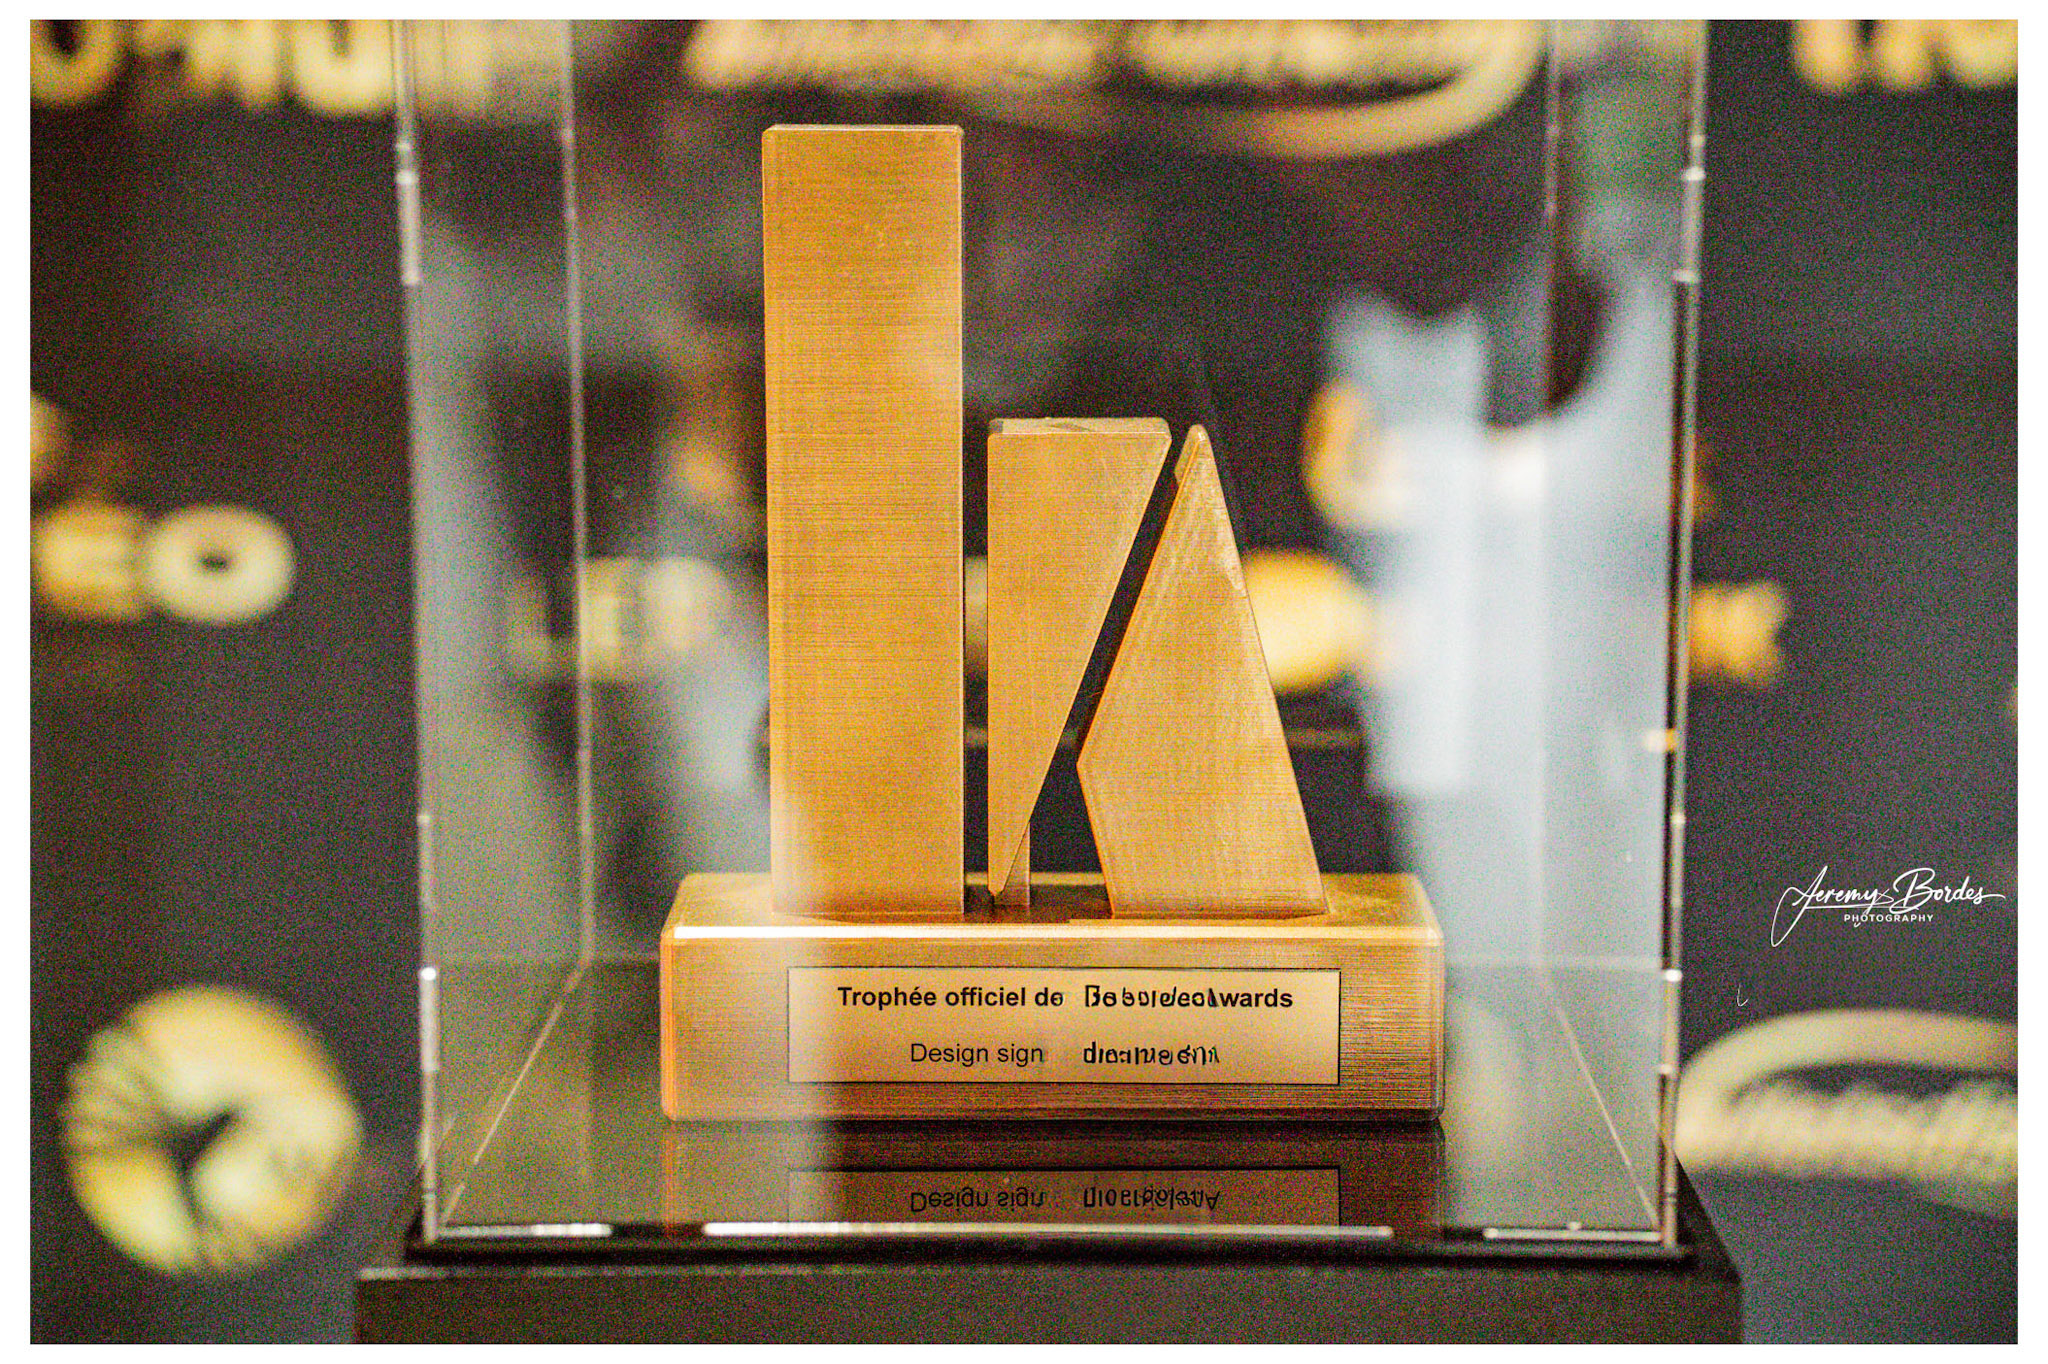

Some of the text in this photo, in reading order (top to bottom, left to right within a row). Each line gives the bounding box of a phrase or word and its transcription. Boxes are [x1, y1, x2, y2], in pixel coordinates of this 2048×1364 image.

[837, 986, 937, 1011] Trophée
[945, 986, 1026, 1007] officiel
[1034, 986, 1065, 1007] de
[910, 1043, 1044, 1068] Design sign
